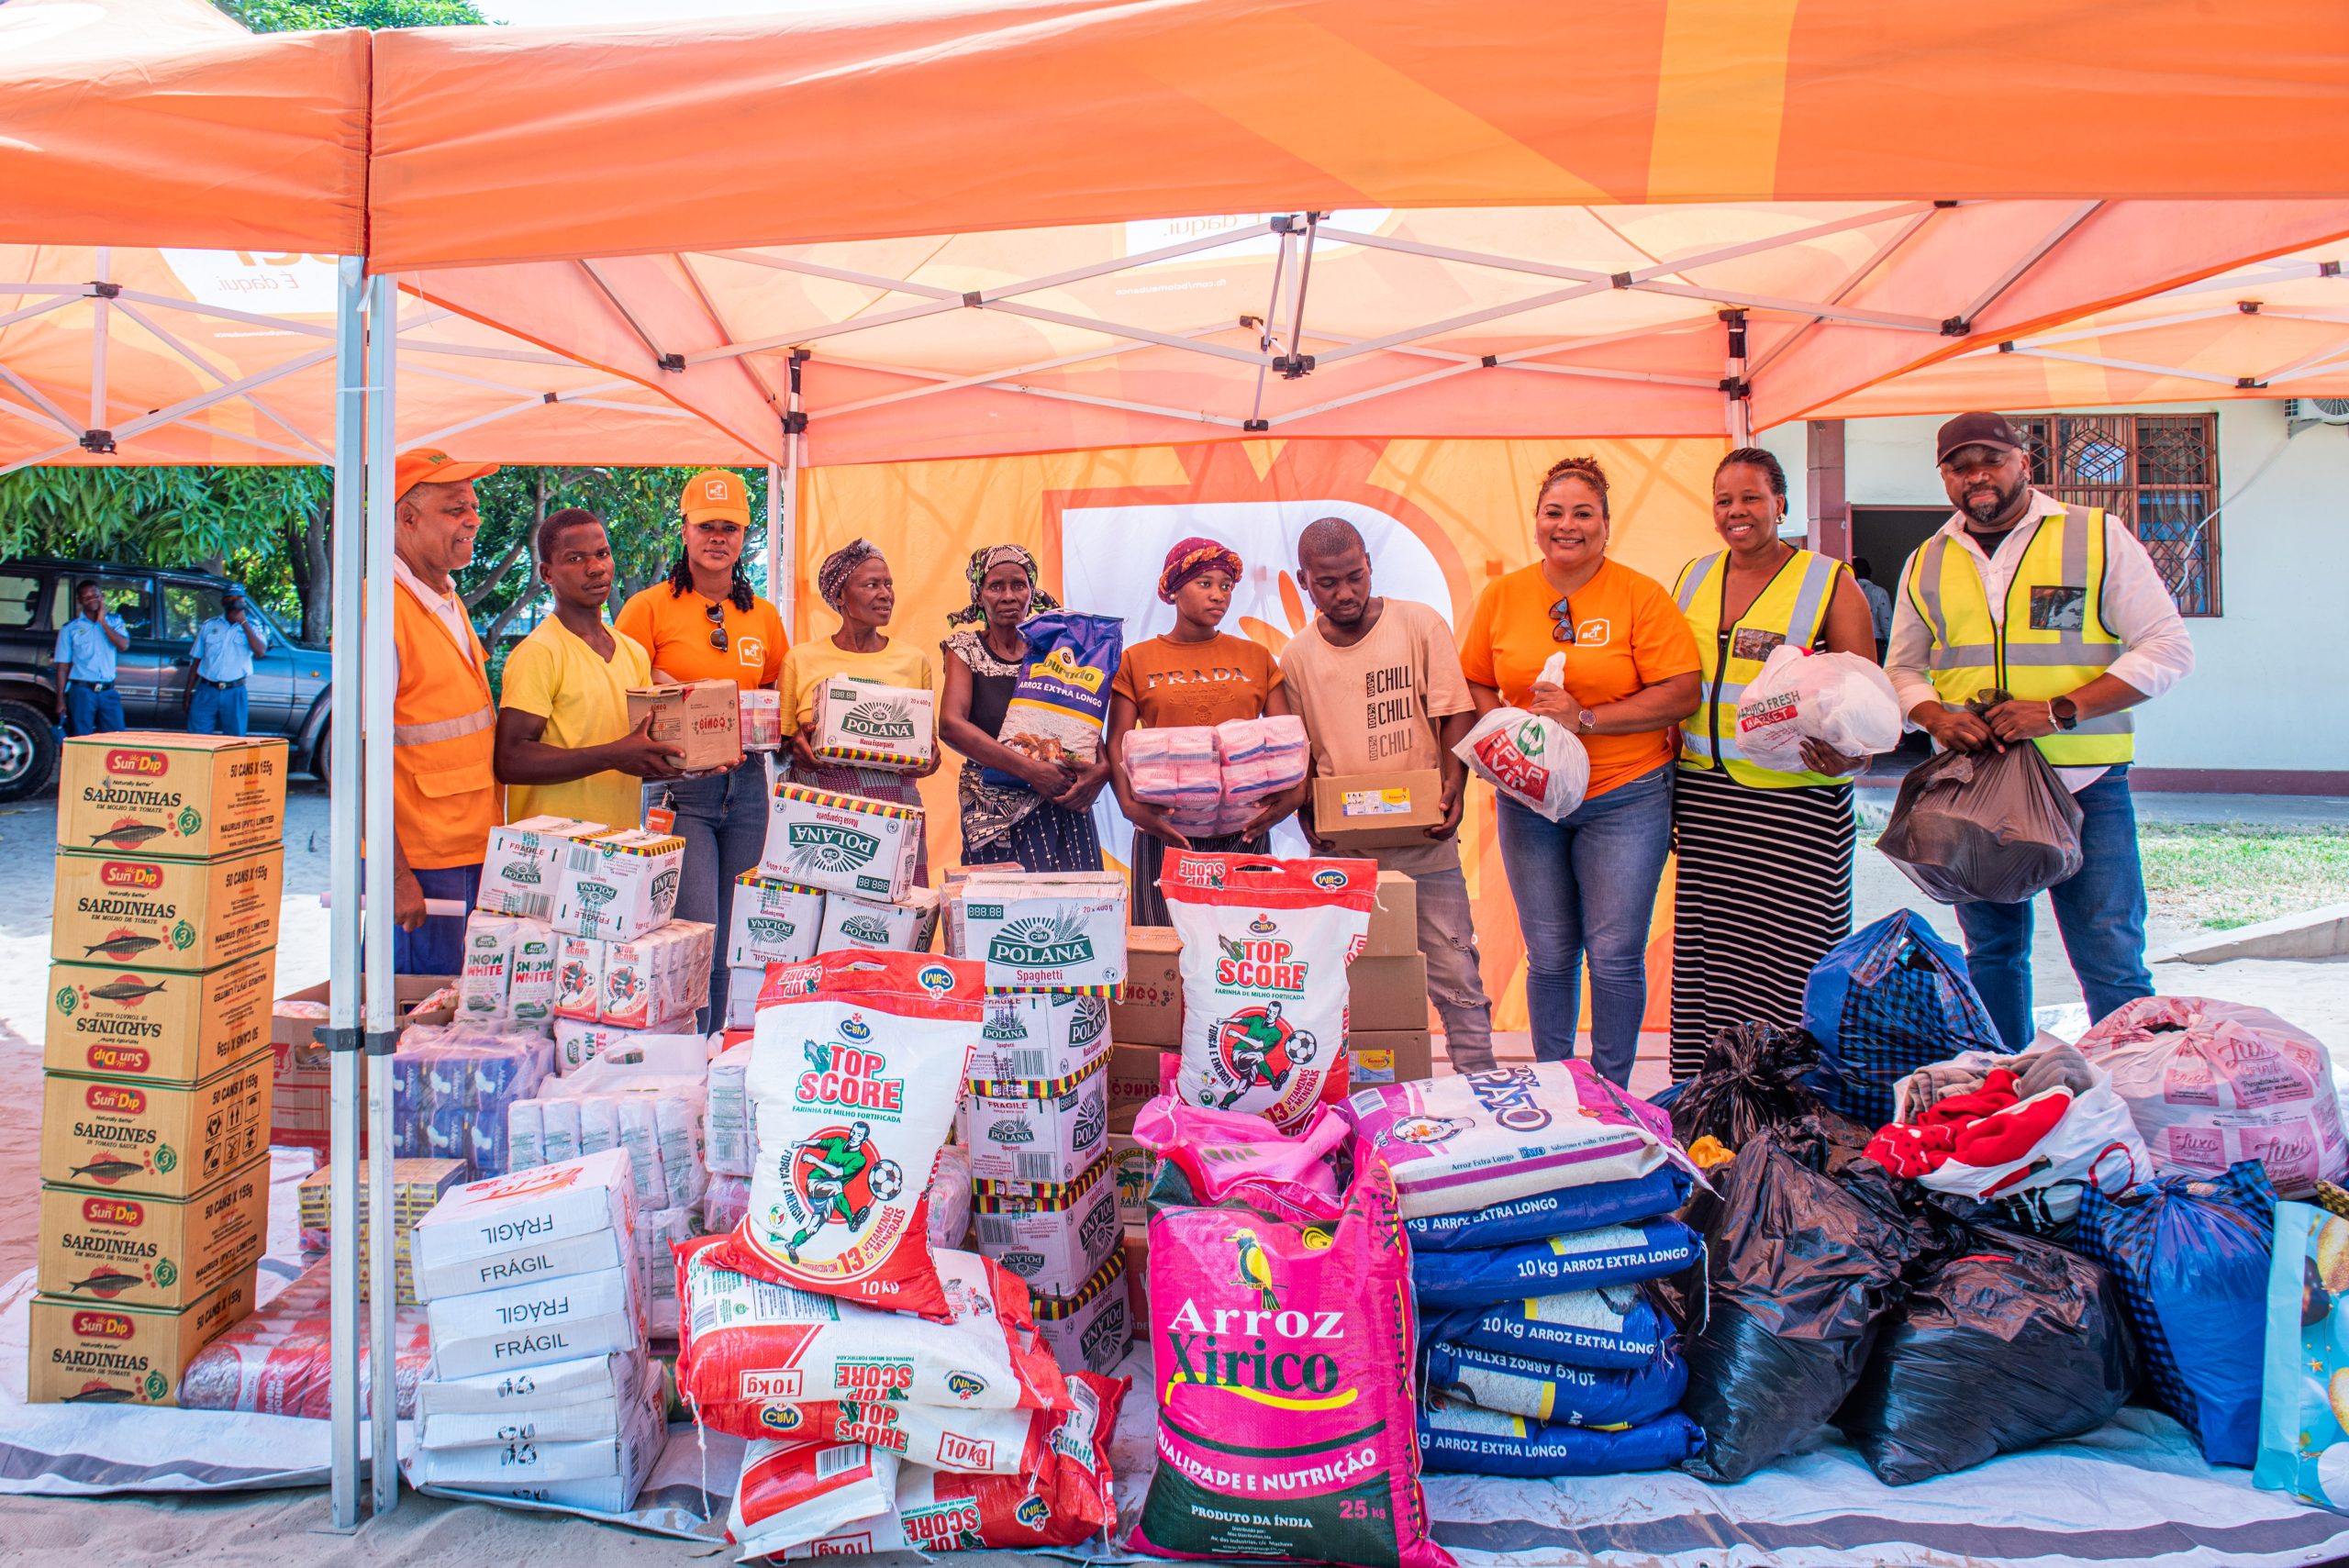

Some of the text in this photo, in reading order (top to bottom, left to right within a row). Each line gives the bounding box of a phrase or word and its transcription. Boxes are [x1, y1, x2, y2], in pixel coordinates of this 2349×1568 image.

[1147, 667, 1252, 689] PRADA
[1366, 665, 1412, 698] 100% CHILL
[1019, 681, 1102, 708] ARROZ EXTRA LONGO
[1766, 690, 1800, 710] FRESH
[1367, 696, 1413, 729] 100% CHILL
[1745, 707, 1788, 730] MARKET
[846, 717, 911, 737] POLANA
[1380, 728, 1413, 758] CHILL
[112, 755, 162, 773] Sun Dip
[83, 786, 182, 807] SARDINHAS
[795, 827, 874, 854] POLANA
[107, 867, 157, 885] Sun Dip
[504, 869, 538, 883] POLANA
[579, 882, 615, 897] POLANA
[77, 897, 175, 918] SARDINHAS
[751, 919, 794, 932] POLANA
[843, 925, 886, 941] POLANA
[468, 953, 504, 965] SNOW
[994, 943, 1088, 963] POLANA
[1242, 940, 1291, 963] TOP
[467, 965, 504, 976] WHITE
[515, 971, 554, 984] WHITE
[1017, 969, 1063, 983] Spaghetti
[1218, 959, 1307, 990] SCORE
[76, 1018, 162, 1038] SARDINES
[985, 1029, 1026, 1039] POLANA
[1072, 1015, 1107, 1042] POLANA
[94, 1049, 143, 1067] Sun Dip
[829, 1043, 883, 1079] TOP
[1211, 1056, 1234, 1089] ENERGIA
[797, 1073, 902, 1111] SCORE
[1285, 1068, 1310, 1107] VITAMINAS
[1295, 1069, 1320, 1107] MINERAIS
[92, 1091, 140, 1110] Sun Dip
[987, 1101, 1029, 1109] FRAGILE
[792, 1106, 901, 1124] FARINHA DE MILHO FORTIFICADA
[1264, 1103, 1289, 1125] 13
[73, 1122, 157, 1144] SARDINES
[991, 1131, 1030, 1141] POLANA
[1075, 1112, 1106, 1146] POLANA
[1452, 1162, 1472, 1171] Arroz
[1474, 1158, 1491, 1168] Extra
[1492, 1154, 1514, 1164] Longo
[89, 1204, 138, 1222] Sun Dip
[784, 1188, 807, 1226] ENERGIA
[1472, 1197, 1558, 1224] EXTRA LONGO
[481, 1214, 554, 1245] FRÁGIL
[863, 1205, 895, 1251] VITAMINAS
[873, 1207, 906, 1253] MINERAIS
[1082, 1197, 1114, 1243] POLANA
[61, 1234, 158, 1258] SARDINHAS
[480, 1254, 554, 1283] FRÁGIL
[836, 1247, 866, 1274] 13
[1517, 1247, 1689, 1278] 10 kg ARROZ EXTRA LONGO
[861, 1281, 879, 1296] 10
[495, 1296, 569, 1326] FRÁGIL
[1167, 1297, 1344, 1339] Arroz
[79, 1319, 128, 1337] Sun Dip
[1482, 1317, 1616, 1351] 10 kg ARROZ EXTRA
[494, 1332, 569, 1359] FRÁGIL
[51, 1348, 149, 1371] SARDINHAS
[1166, 1332, 1339, 1394] Xirico
[1509, 1357, 1552, 1375] ARROZ
[747, 1377, 796, 1396] 10 kg
[836, 1365, 912, 1389] SCORE
[859, 1401, 897, 1423] TOP
[838, 1419, 908, 1451] SCORE
[947, 1439, 987, 1467] 10 kg
[1157, 1427, 1376, 1491] QUALIDADE E NUTRIÇÃO
[1435, 1438, 1567, 1458] ARROZ EXTRA LONGO
[1191, 1505, 1313, 1529] PRODUTO DA ÍNDIA
[1339, 1500, 1386, 1520] 25 kg
[903, 1507, 978, 1543] SCORE
